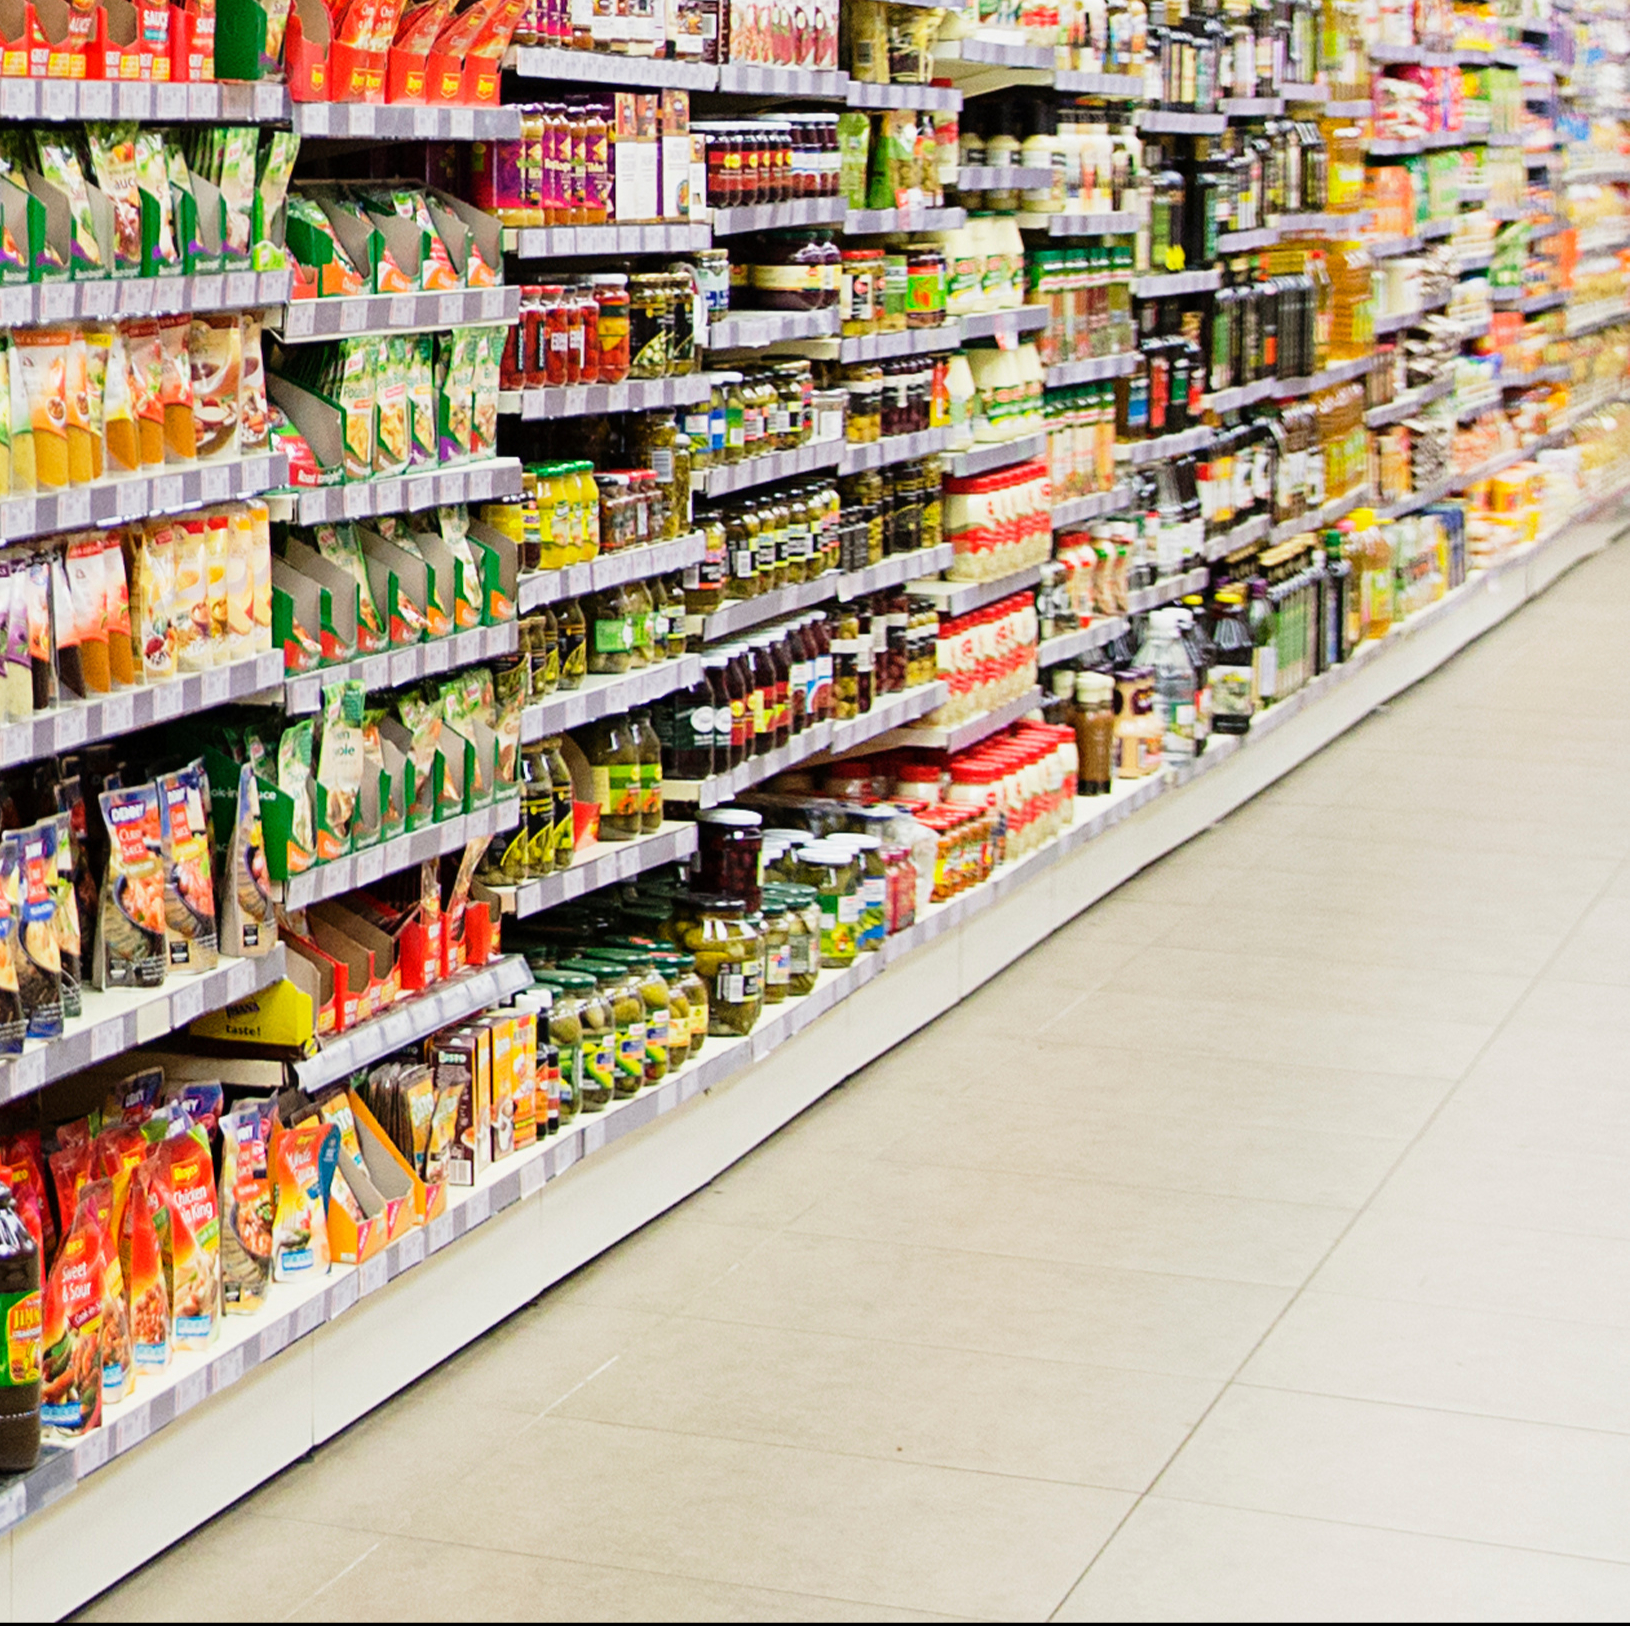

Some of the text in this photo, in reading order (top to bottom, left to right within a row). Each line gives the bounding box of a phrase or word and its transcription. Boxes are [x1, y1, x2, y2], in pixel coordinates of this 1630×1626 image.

[143, 10, 169, 26] SAUCE
[226, 1024, 261, 1037] taste!
[438, 1050, 467, 1064] BISTO
[173, 1185, 207, 1206] Chicken
[191, 1201, 214, 1222] King
[61, 1261, 88, 1283] Sweet
[69, 1281, 92, 1302] Sour
